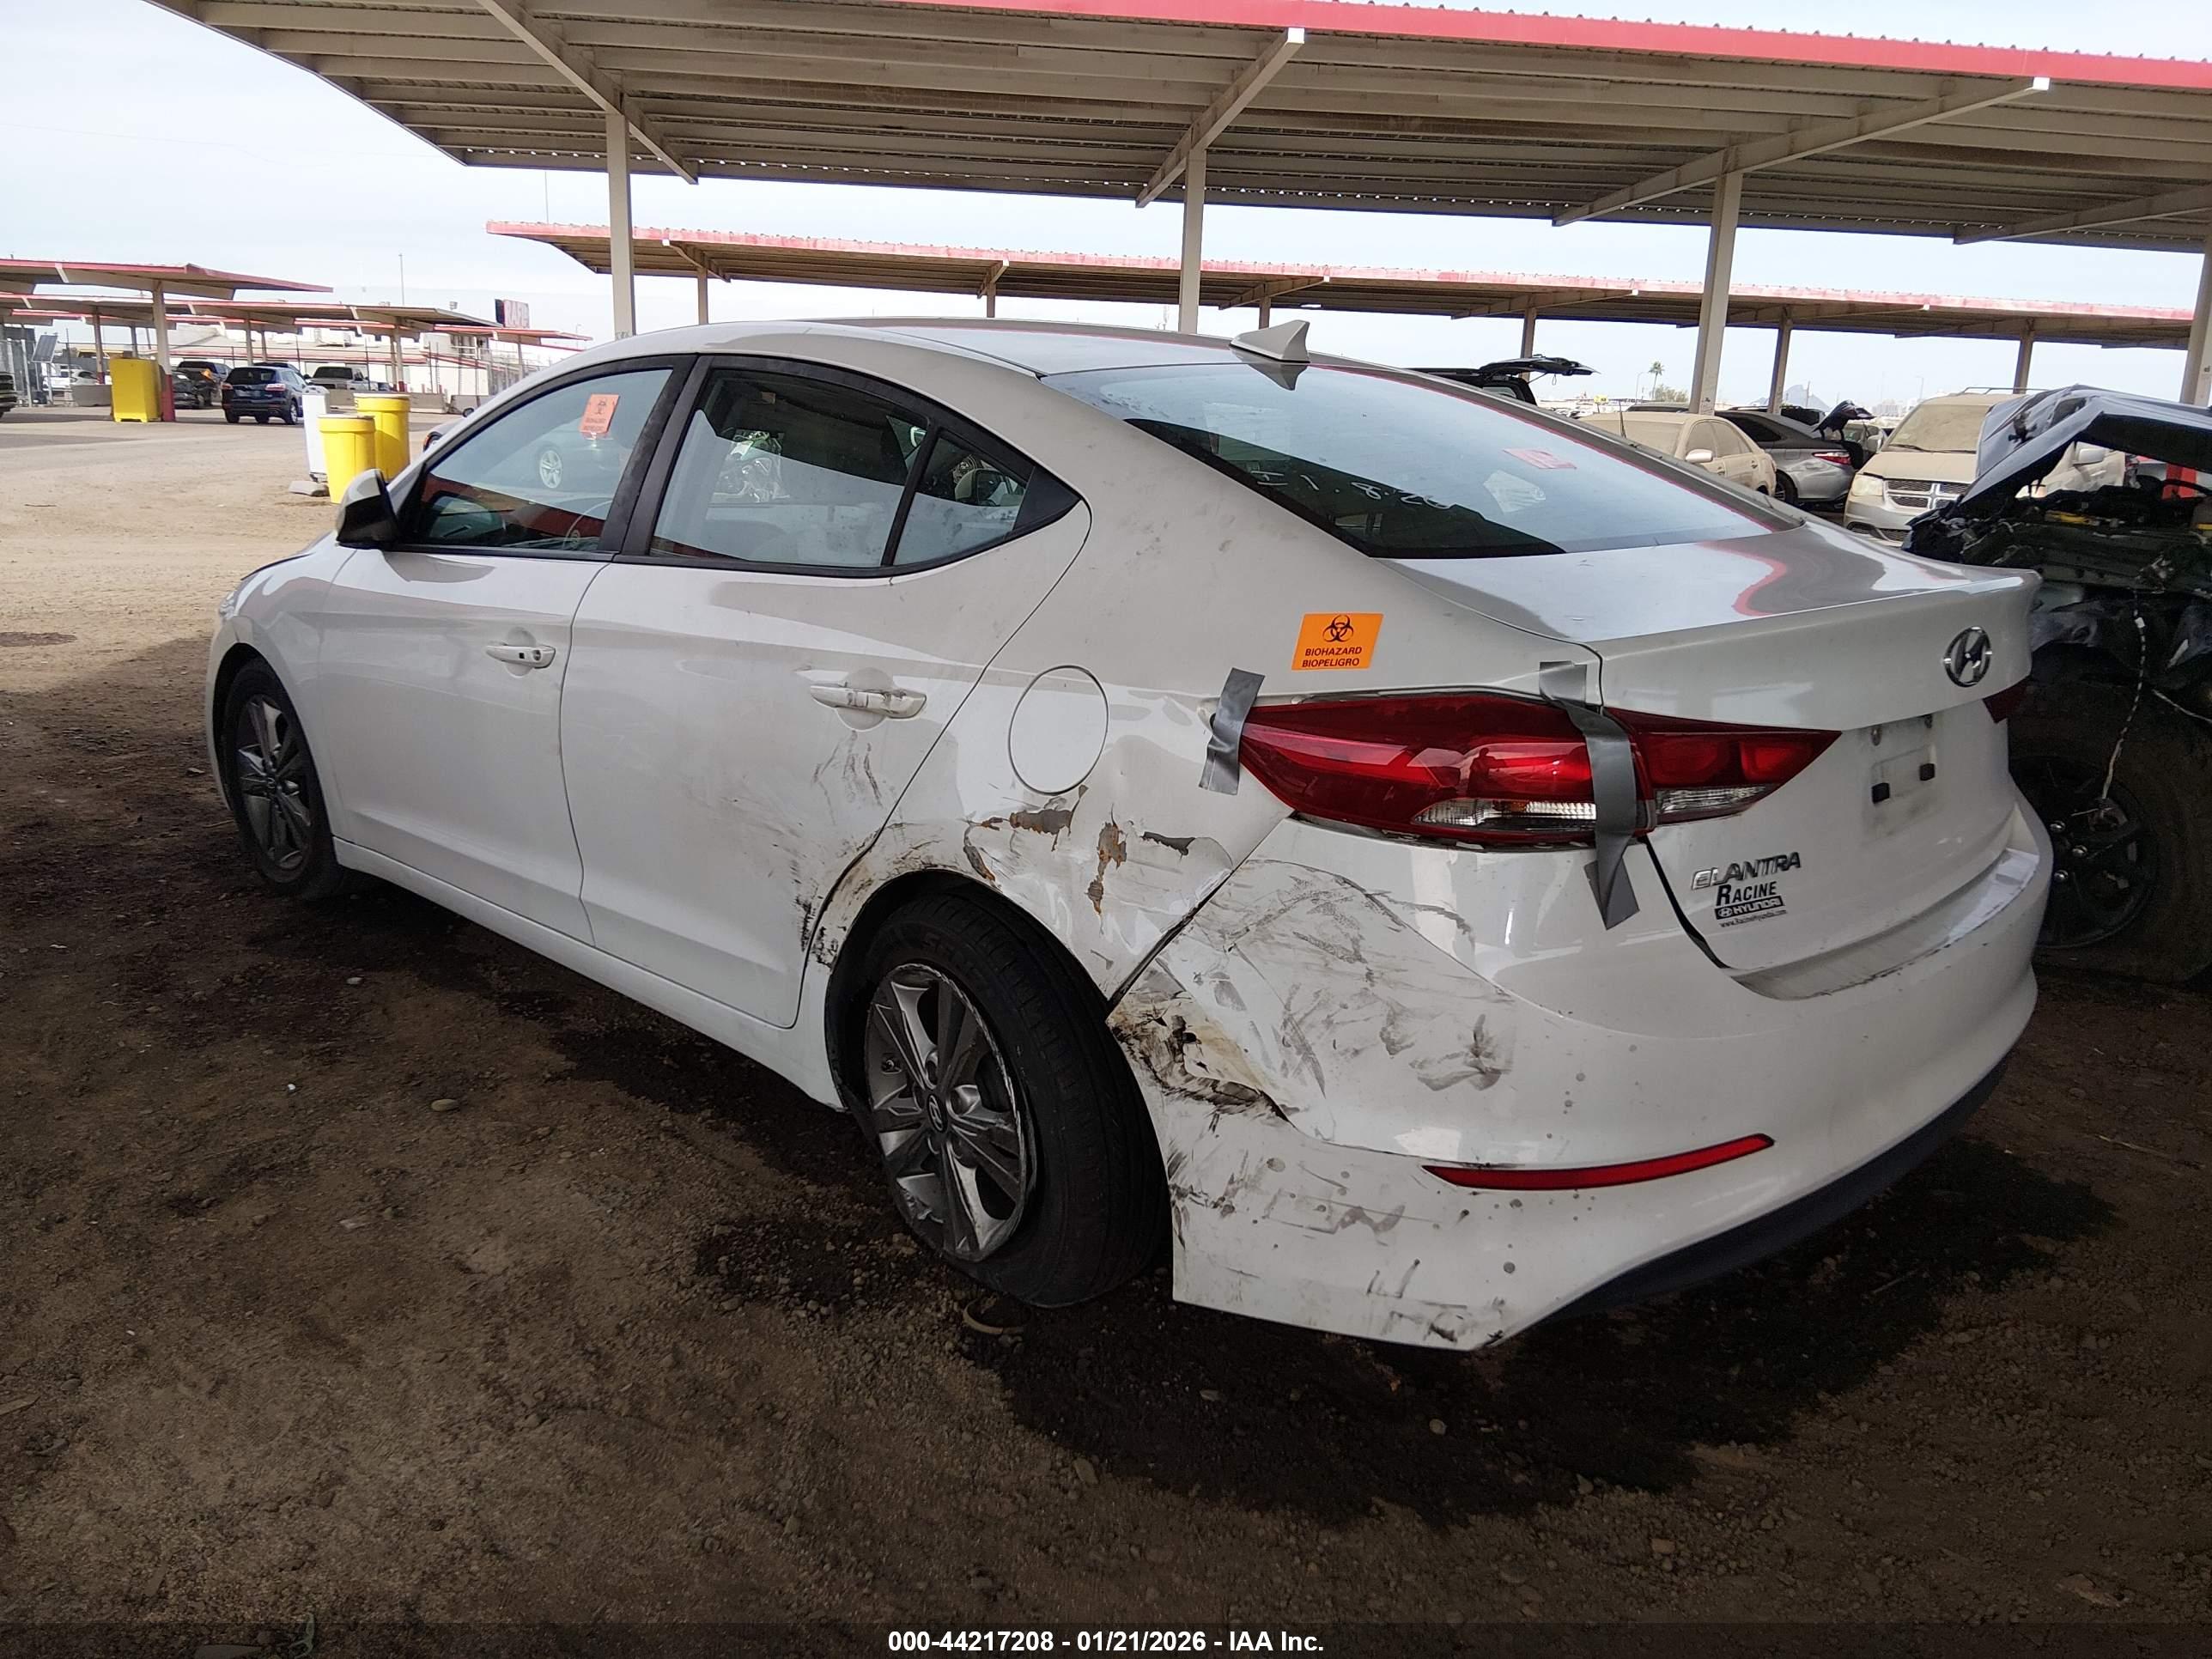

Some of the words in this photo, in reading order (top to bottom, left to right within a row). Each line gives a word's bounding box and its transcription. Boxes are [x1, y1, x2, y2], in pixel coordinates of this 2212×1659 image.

[1305, 647, 1362, 656] BIOHAZARD
[1302, 658, 1359, 667] BIOPELIGRO
[1692, 851, 1801, 890] ELANTRA
[1717, 880, 1777, 906] RACINE
